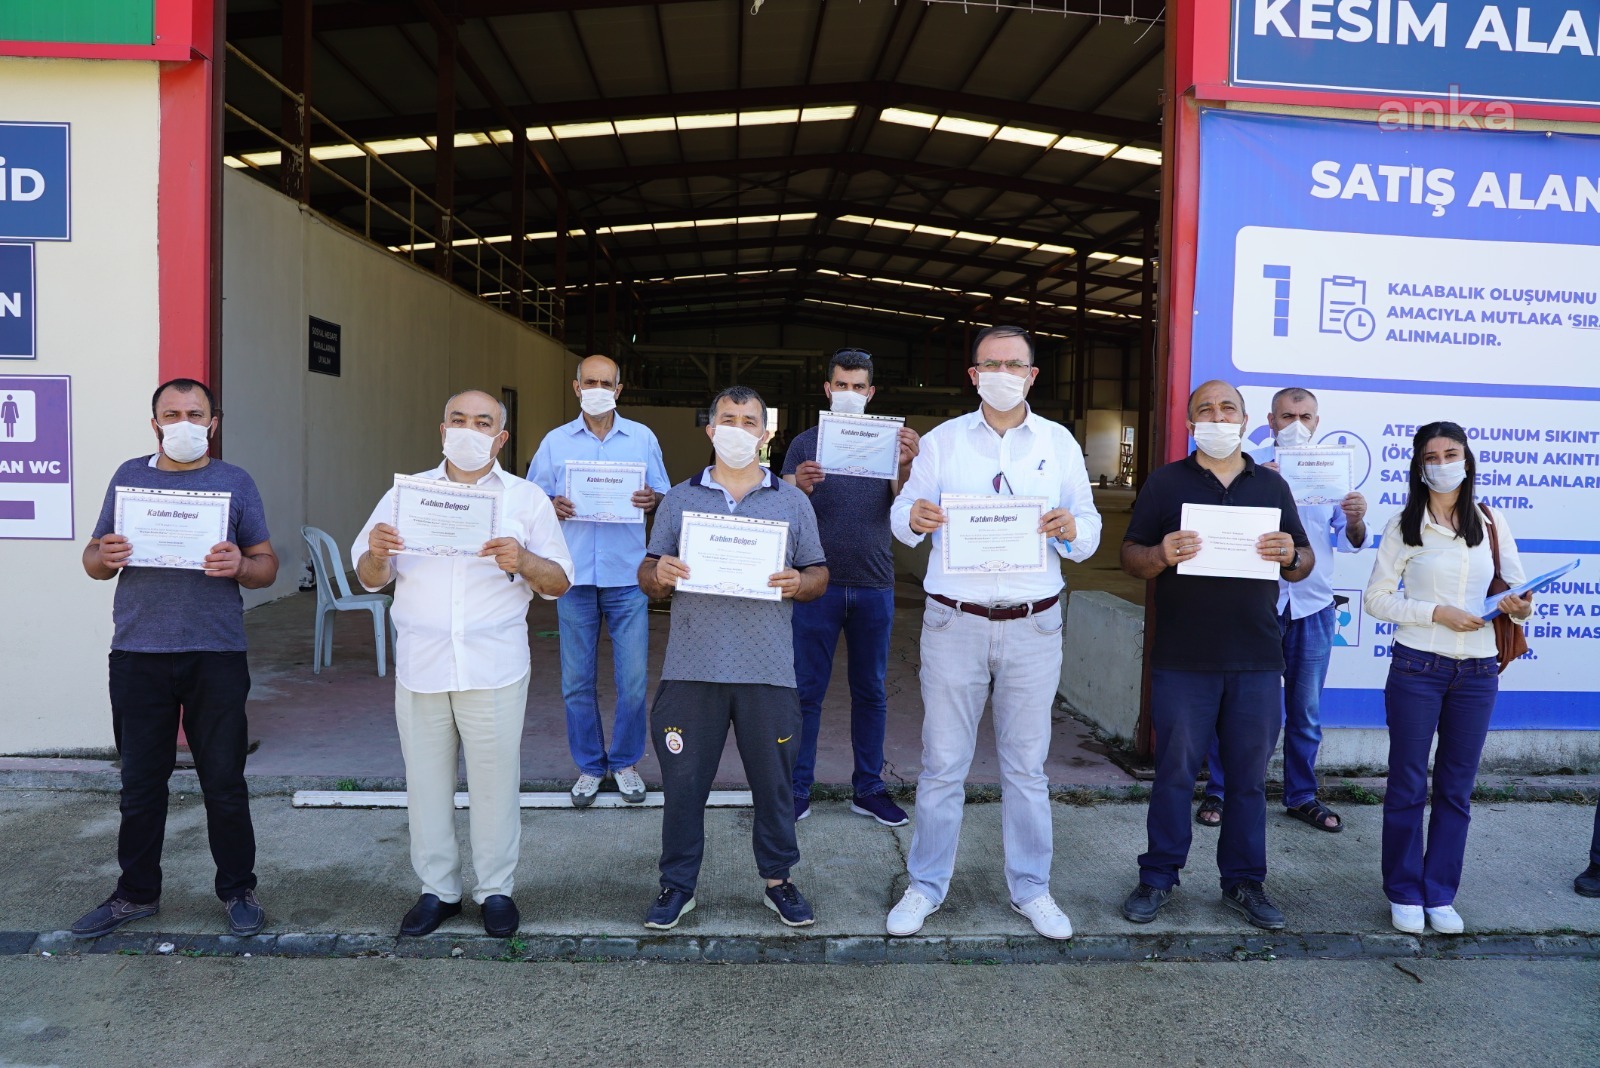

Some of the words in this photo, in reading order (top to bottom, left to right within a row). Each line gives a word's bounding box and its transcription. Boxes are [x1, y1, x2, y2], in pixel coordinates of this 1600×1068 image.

[1465, 5, 1600, 57] ALA
[1310, 160, 1456, 218] SATIŞ
[1388, 283, 1486, 300] KALABALIK
[1489, 288, 1597, 306] OLUŞUMUNU
[1386, 306, 1477, 323] AMACIYLA
[1481, 311, 1564, 326] MUTLAKA
[1567, 313, 1600, 328] ‘SIR
[1385, 329, 1502, 347] ALINMALIDIR.
[1463, 426, 1541, 442] OLUNUM
[1480, 450, 1539, 465] BURUN
[28, 460, 61, 475] WC
[1474, 469, 1512, 487] ESİM
[1564, 604, 1586, 616] YA
[1534, 621, 1562, 638] BİR
[1566, 626, 1600, 639] MAS
